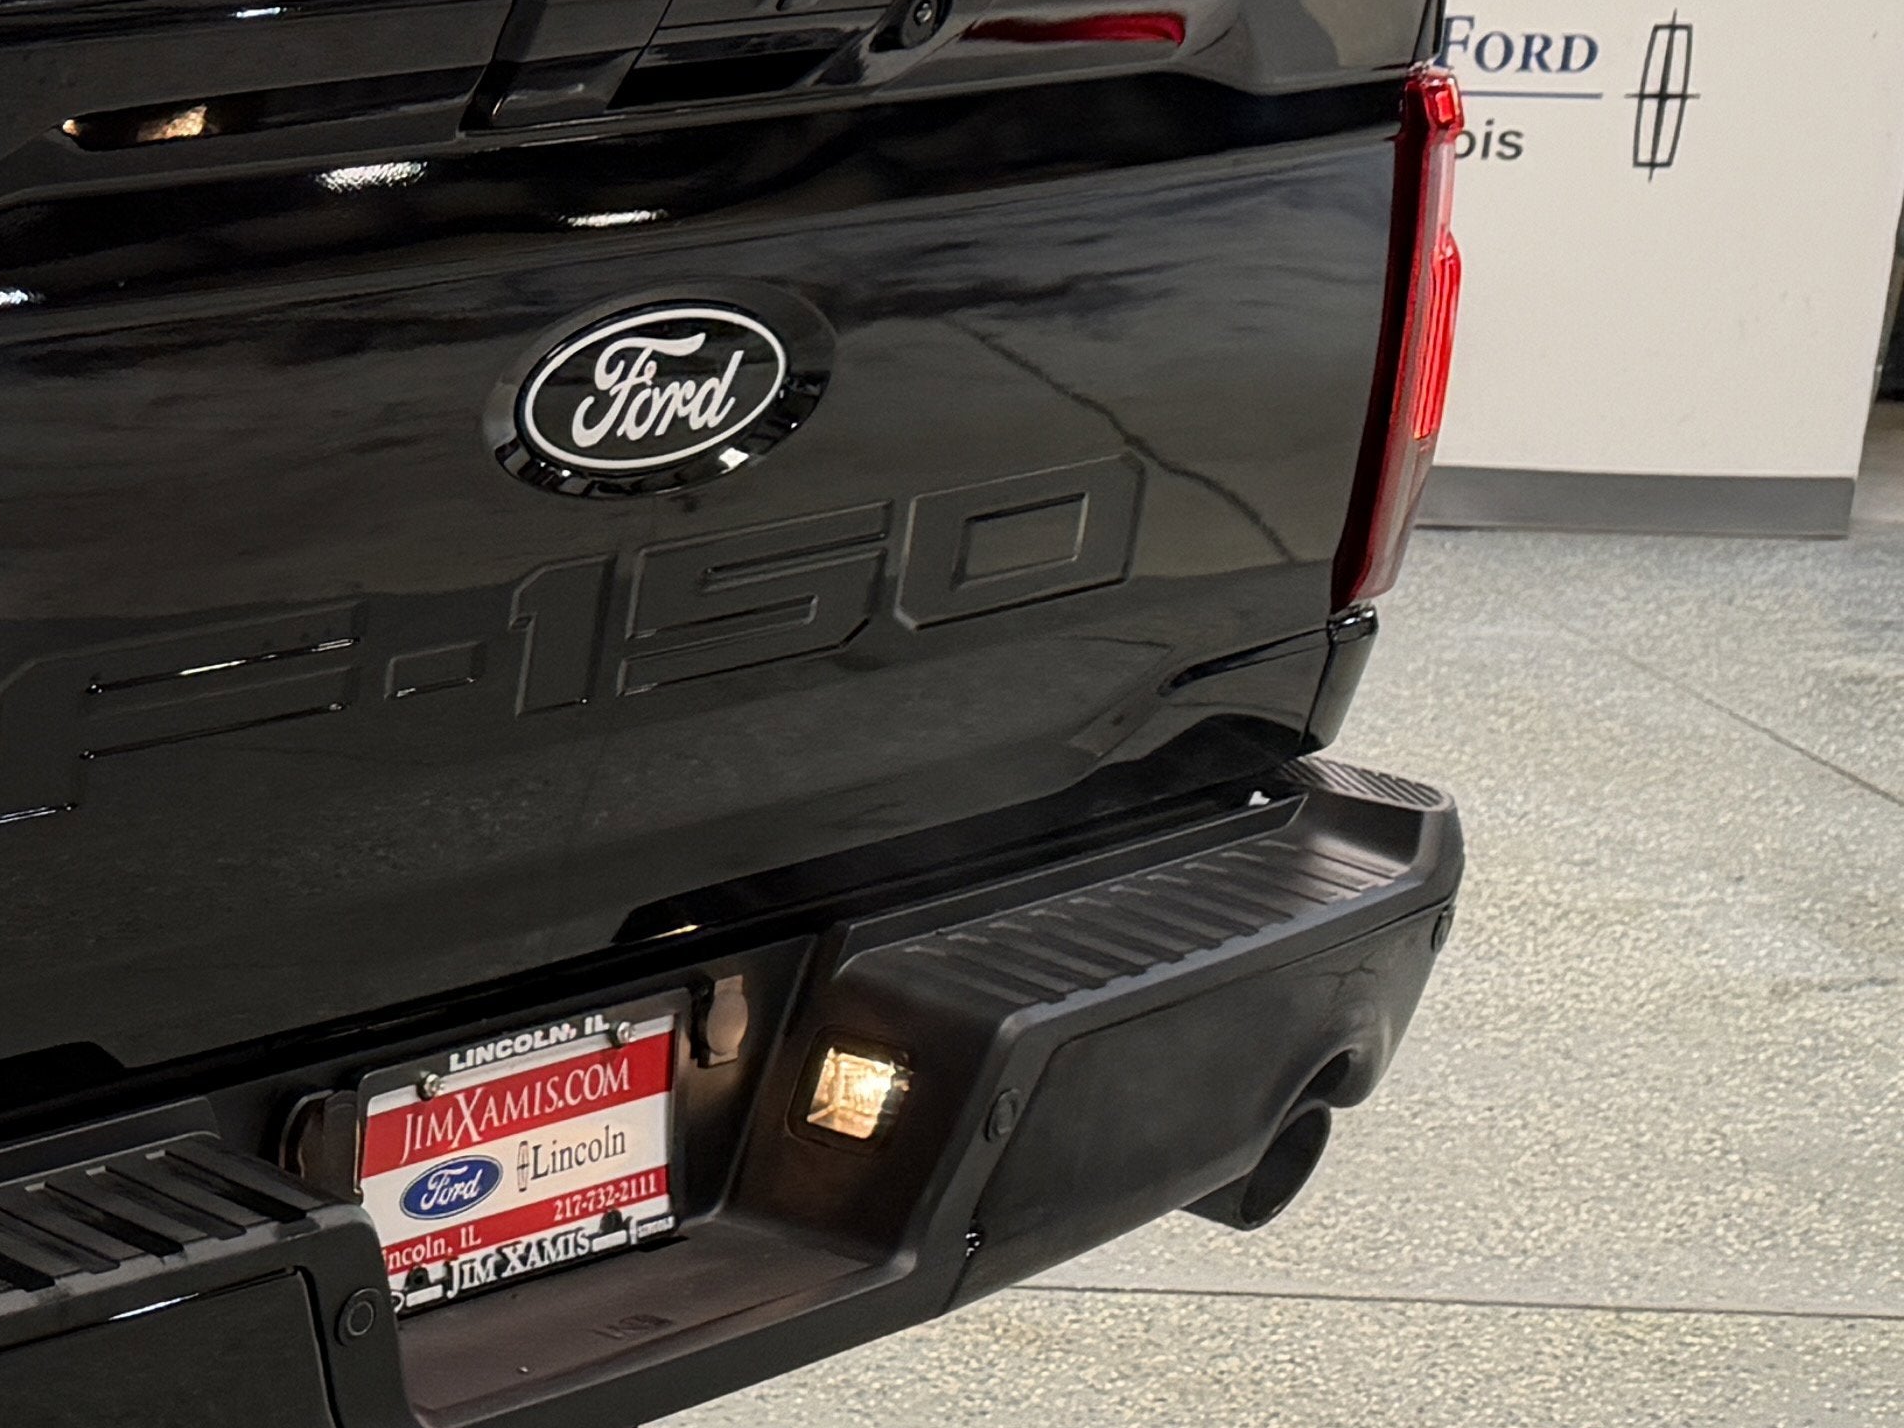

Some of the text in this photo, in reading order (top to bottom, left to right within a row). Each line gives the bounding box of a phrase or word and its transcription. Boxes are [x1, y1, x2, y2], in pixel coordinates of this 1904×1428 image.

[1433, 15, 1599, 73] FORD
[572, 333, 744, 448] Ford
[584, 1014, 610, 1035] IL
[531, 1124, 626, 1180] Lincoln
[420, 1165, 483, 1211] Ford
[554, 1173, 657, 1221] 217-732-2111
[461, 1225, 482, 1248] IL
[446, 1231, 591, 1299] JIM XAMIS
